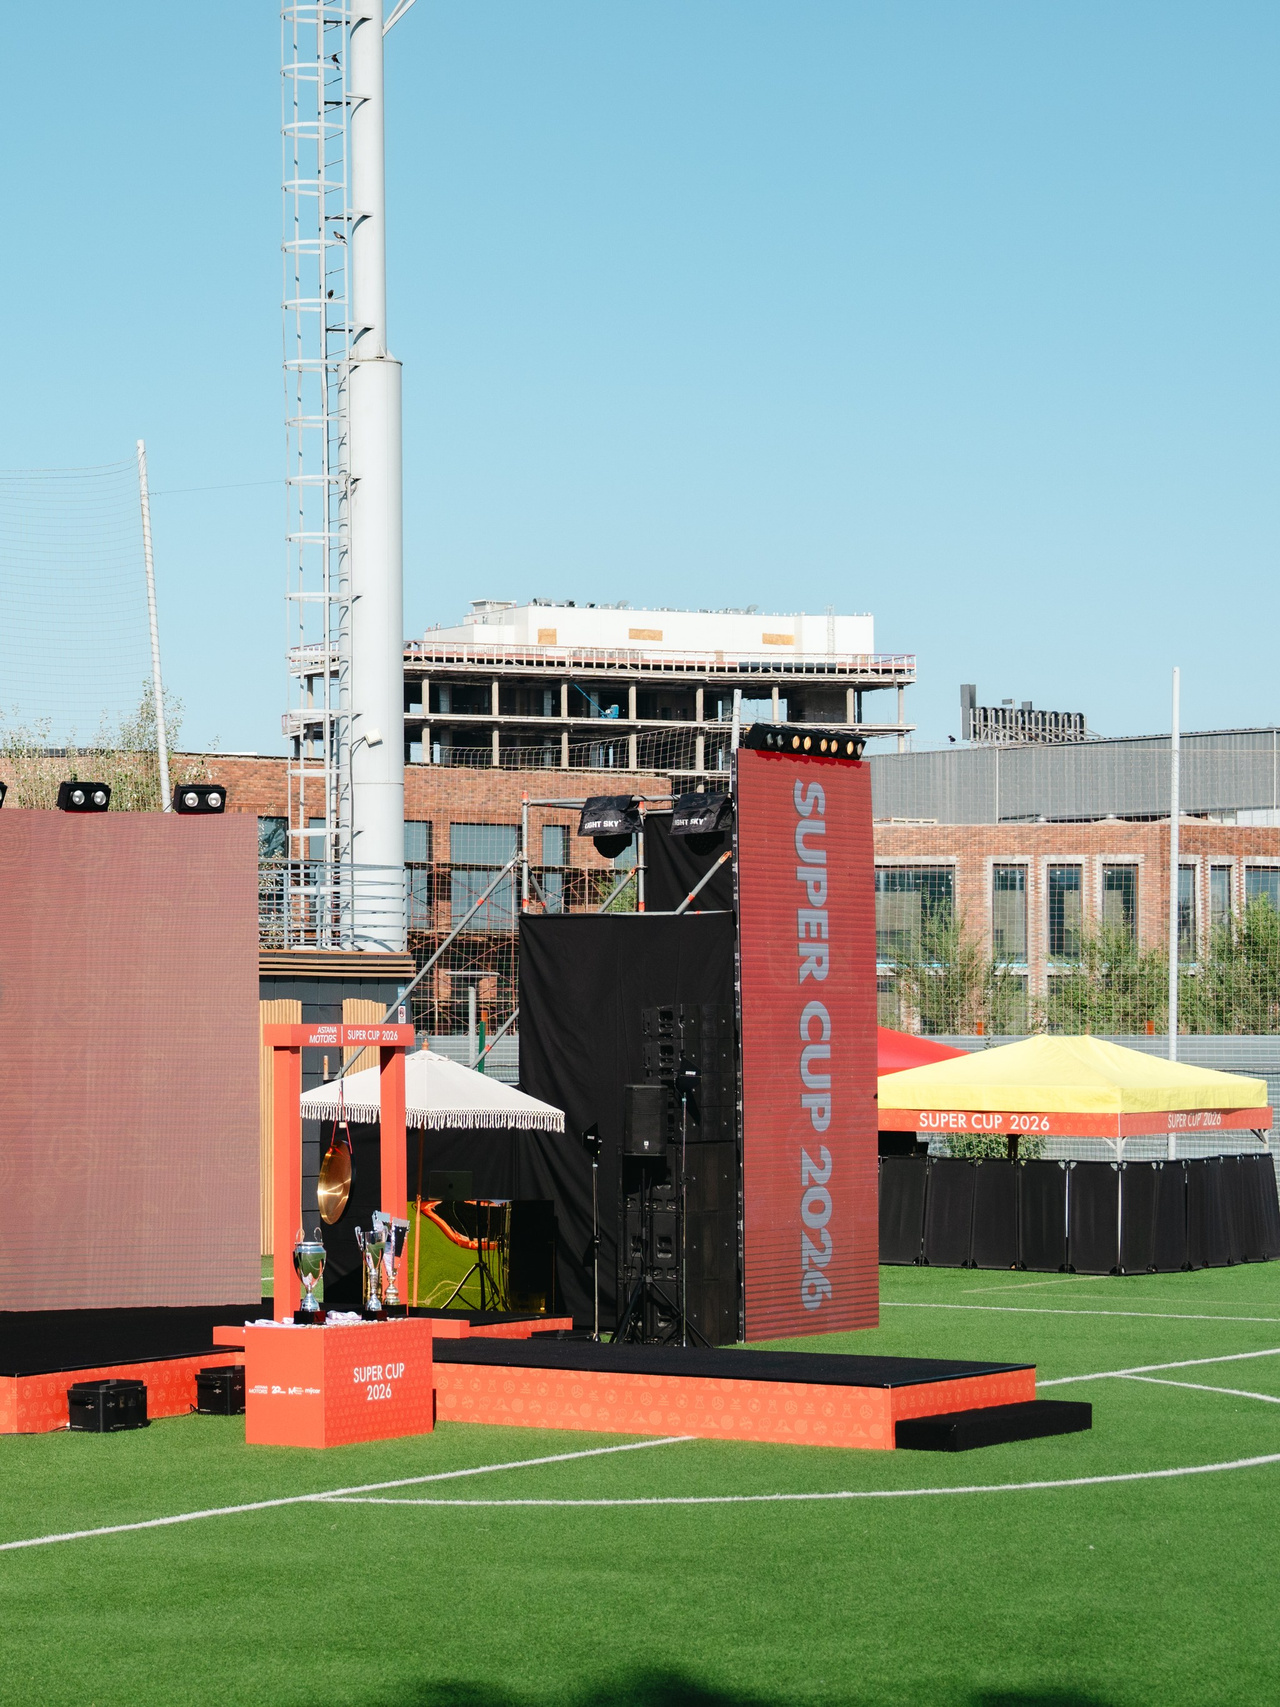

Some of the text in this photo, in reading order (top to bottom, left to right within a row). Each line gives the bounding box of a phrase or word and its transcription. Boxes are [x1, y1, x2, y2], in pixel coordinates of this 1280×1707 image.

[603, 820, 619, 828] SKY
[317, 1026, 337, 1034] ASTANA
[347, 1030, 398, 1041] SUPER CUP 2026
[309, 1035, 337, 1043] MOTORS
[793, 779, 833, 1311] SUPER CUP 2026
[919, 1112, 1050, 1130] SUPER CUP 2026
[1168, 1111, 1222, 1128] SUPER CUP 2026
[353, 1362, 405, 1383] SUPER CUP
[367, 1383, 392, 1400] 2026
